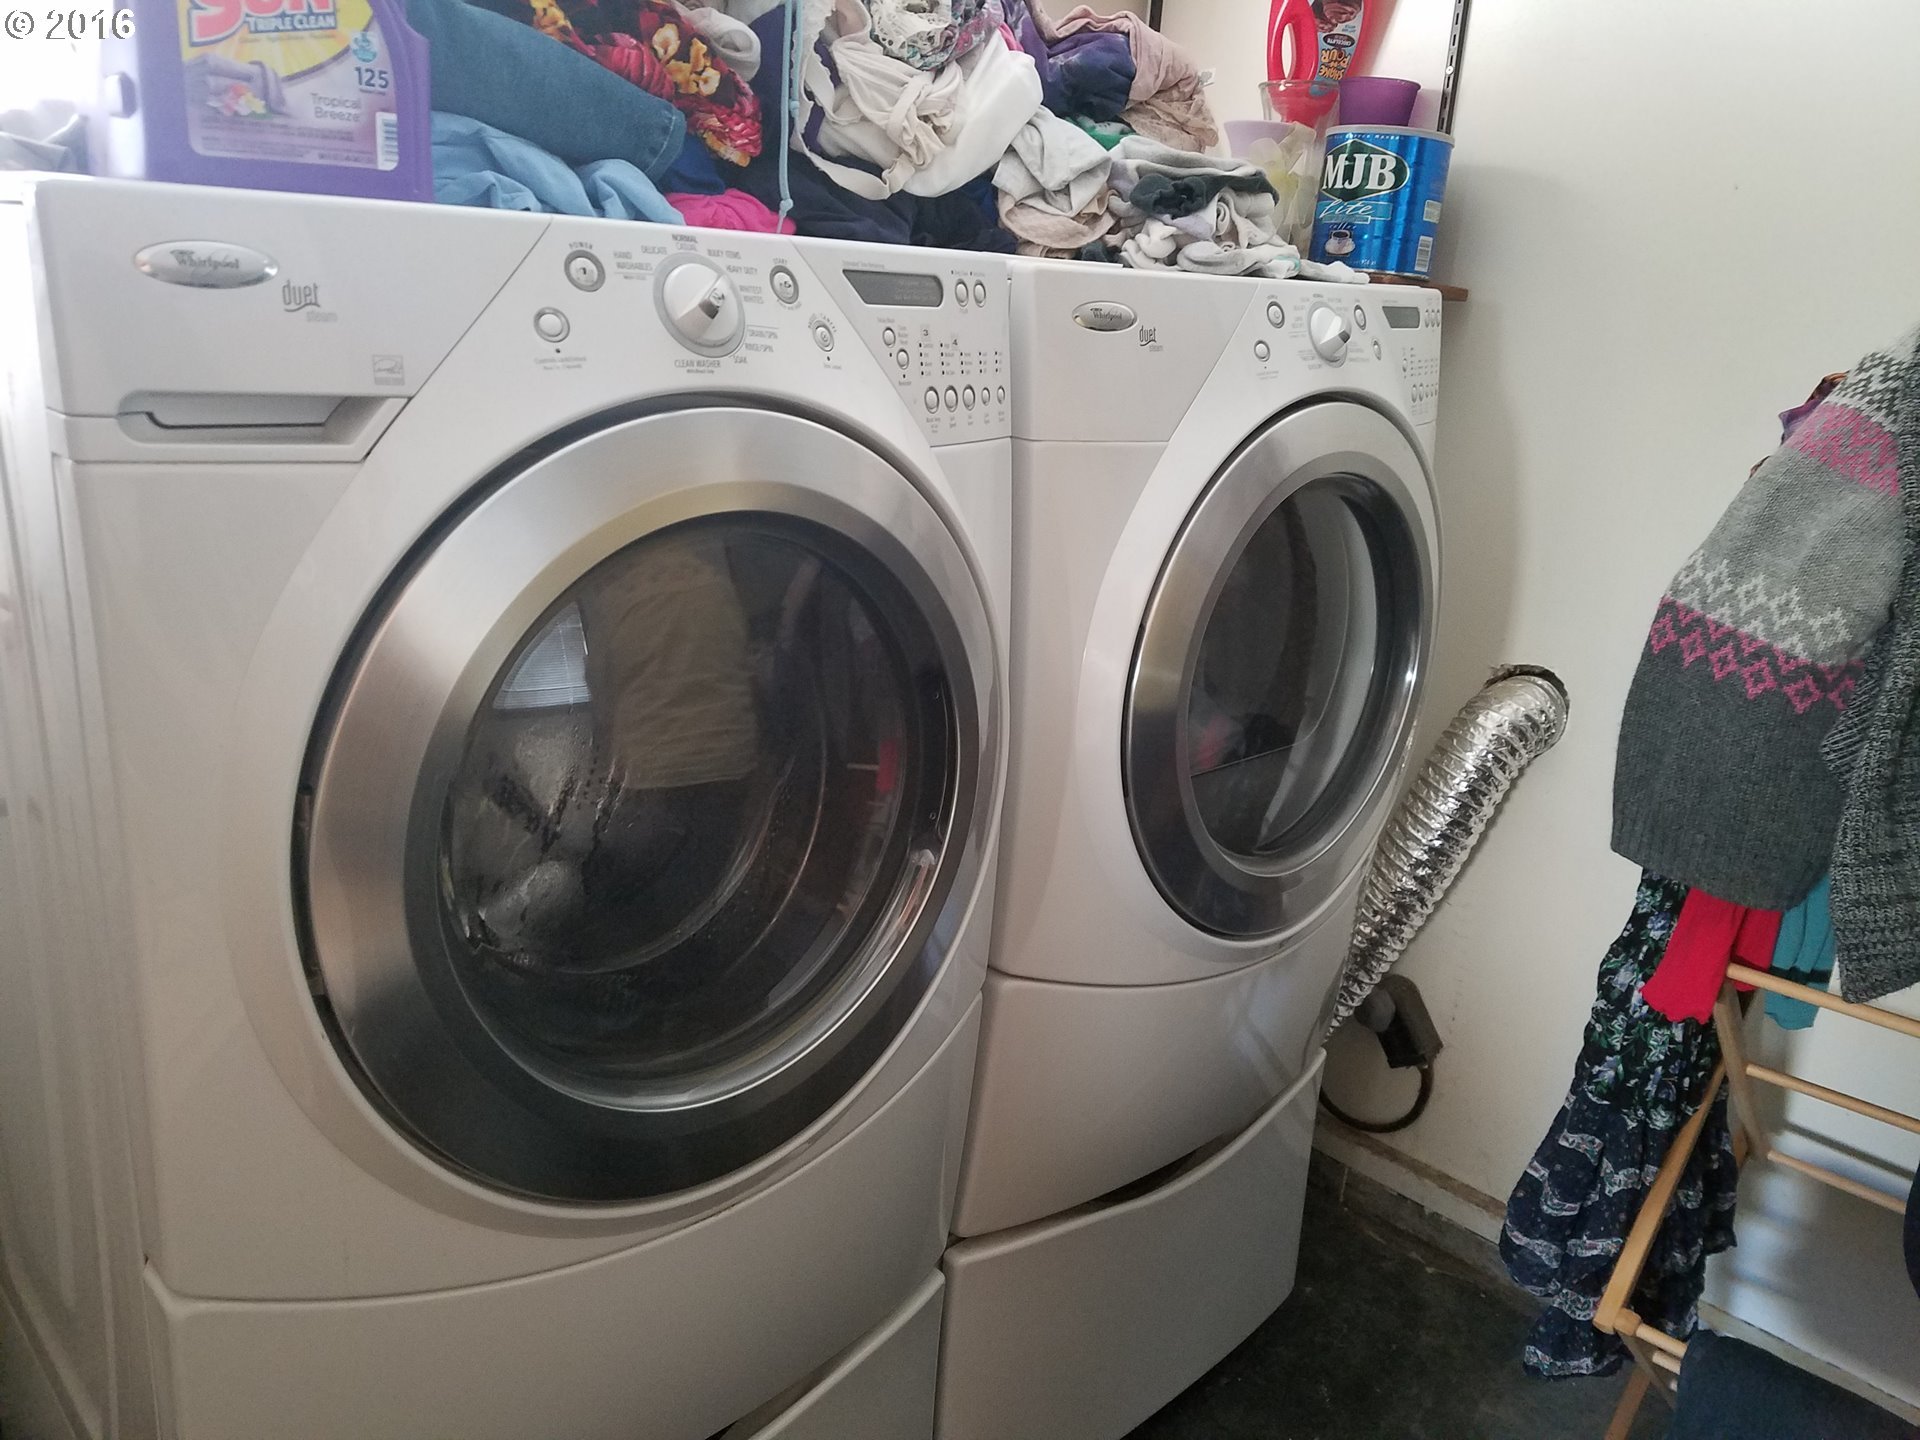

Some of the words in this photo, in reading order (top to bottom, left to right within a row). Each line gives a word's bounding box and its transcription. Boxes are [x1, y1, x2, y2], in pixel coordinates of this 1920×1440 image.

[247, 16, 292, 32] TRIPLE
[292, 13, 336, 30] CLEAN
[1320, 48, 1351, 69] POUR
[354, 66, 390, 89] 125
[310, 92, 363, 110] Tropical
[313, 106, 362, 123] Breeze
[1321, 153, 1397, 191] MJB
[568, 241, 594, 251] POWER
[671, 233, 699, 244] NORMAL
[170, 249, 240, 271] Whirlpool
[281, 279, 321, 308] duet
[1089, 306, 1124, 321] Whirlpool
[1138, 324, 1157, 344] duet
[674, 358, 696, 369] CLEAN
[696, 358, 722, 369] WASHER
